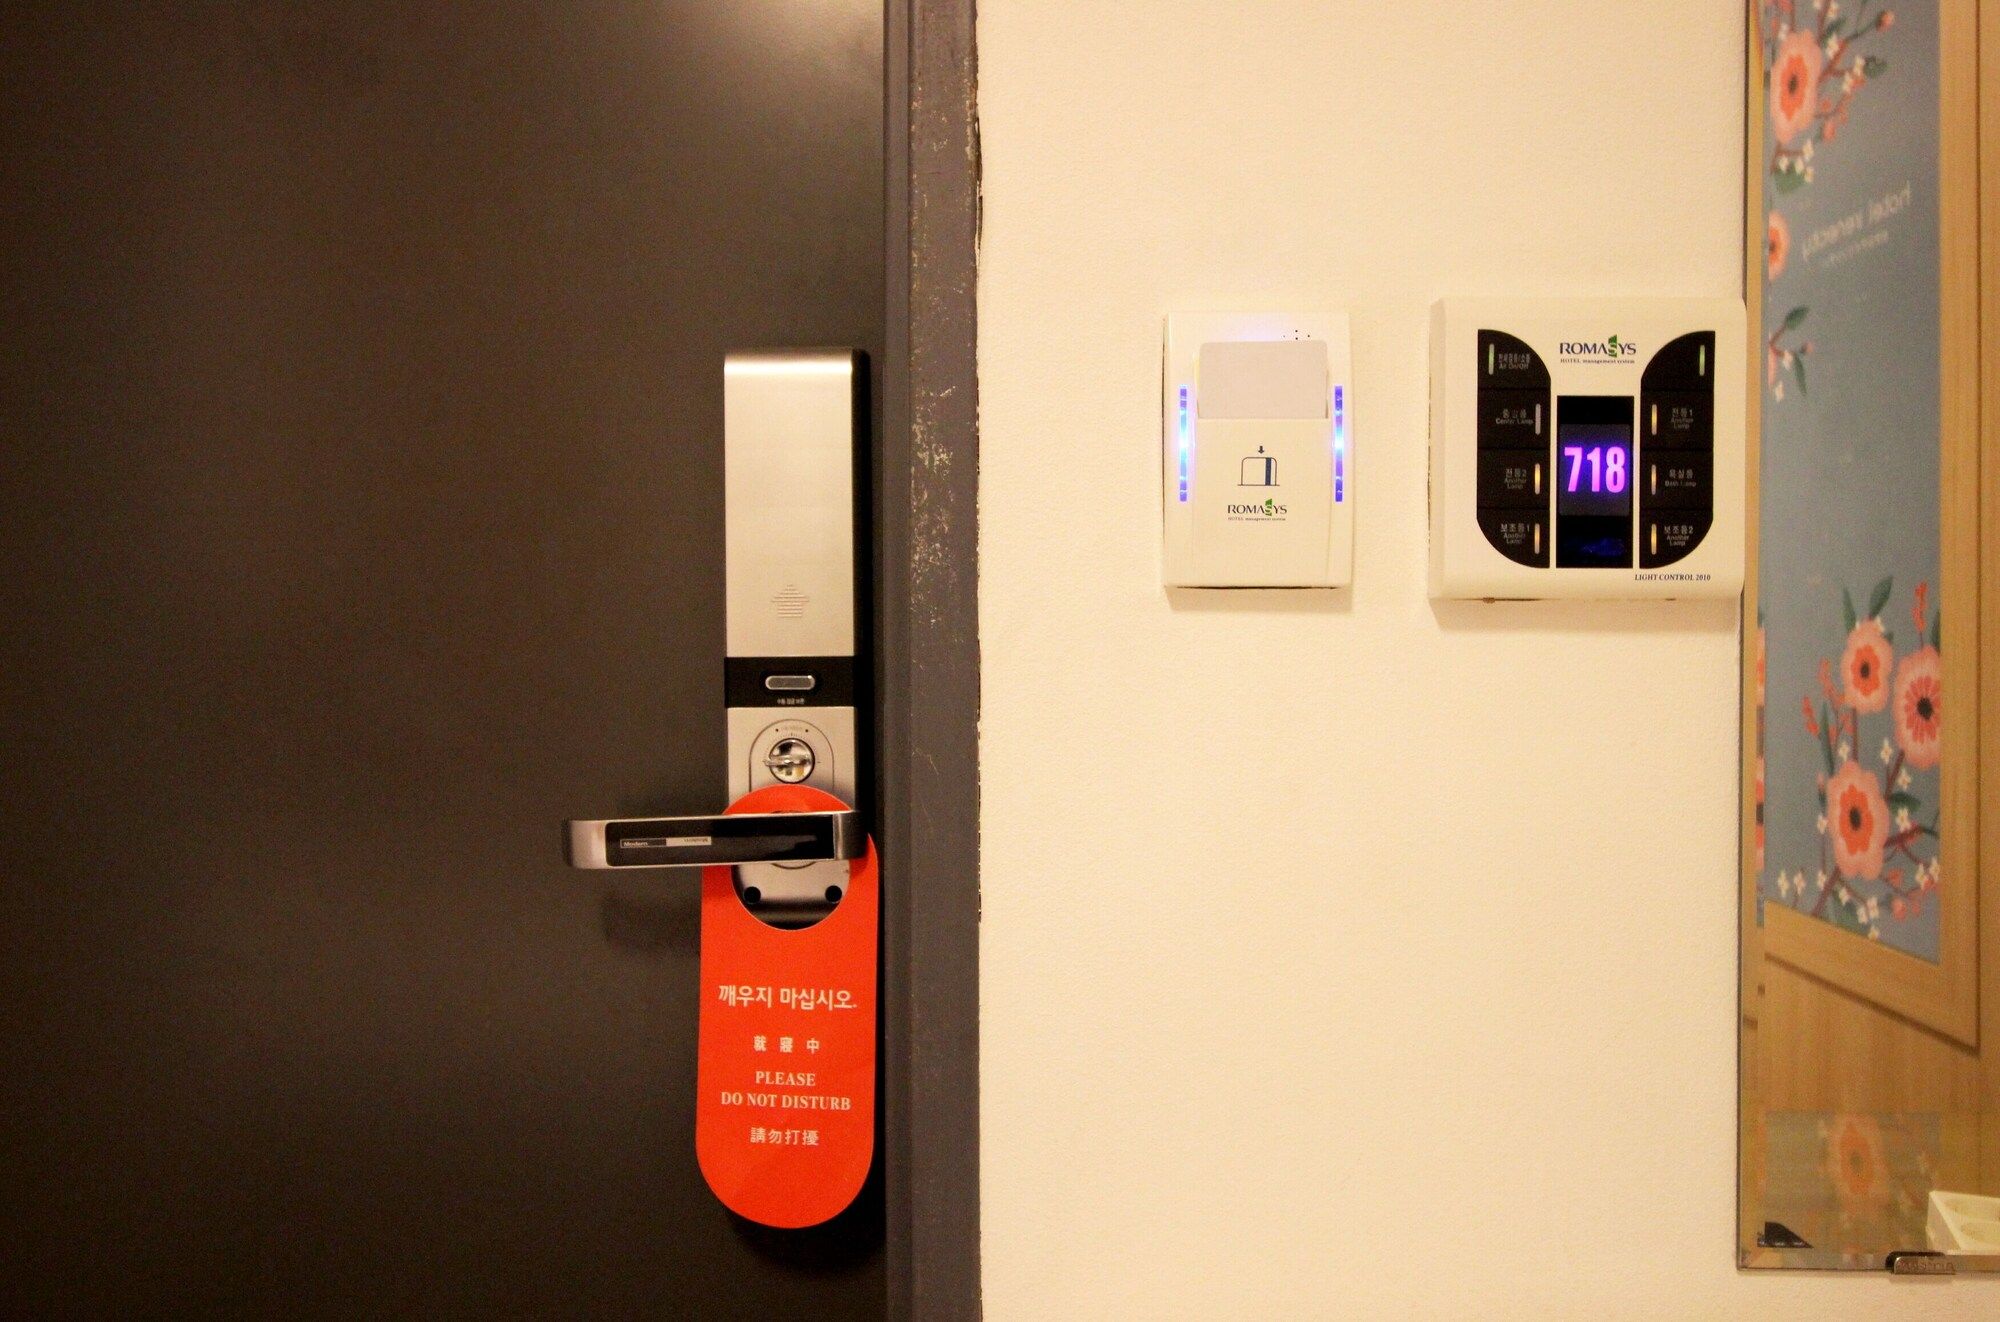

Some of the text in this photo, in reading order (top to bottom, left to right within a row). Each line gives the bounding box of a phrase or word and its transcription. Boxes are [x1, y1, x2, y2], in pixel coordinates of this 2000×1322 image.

[1559, 334, 1637, 358] ROMASYS
[1564, 446, 1626, 493] 718
[1227, 498, 1288, 516] ROMASYS
[718, 984, 772, 1008] 깨우지
[755, 1071, 816, 1087] PLEASE
[721, 1091, 851, 1111] DO NOT DISTURB
[750, 1127, 819, 1146] 請勿打擾
